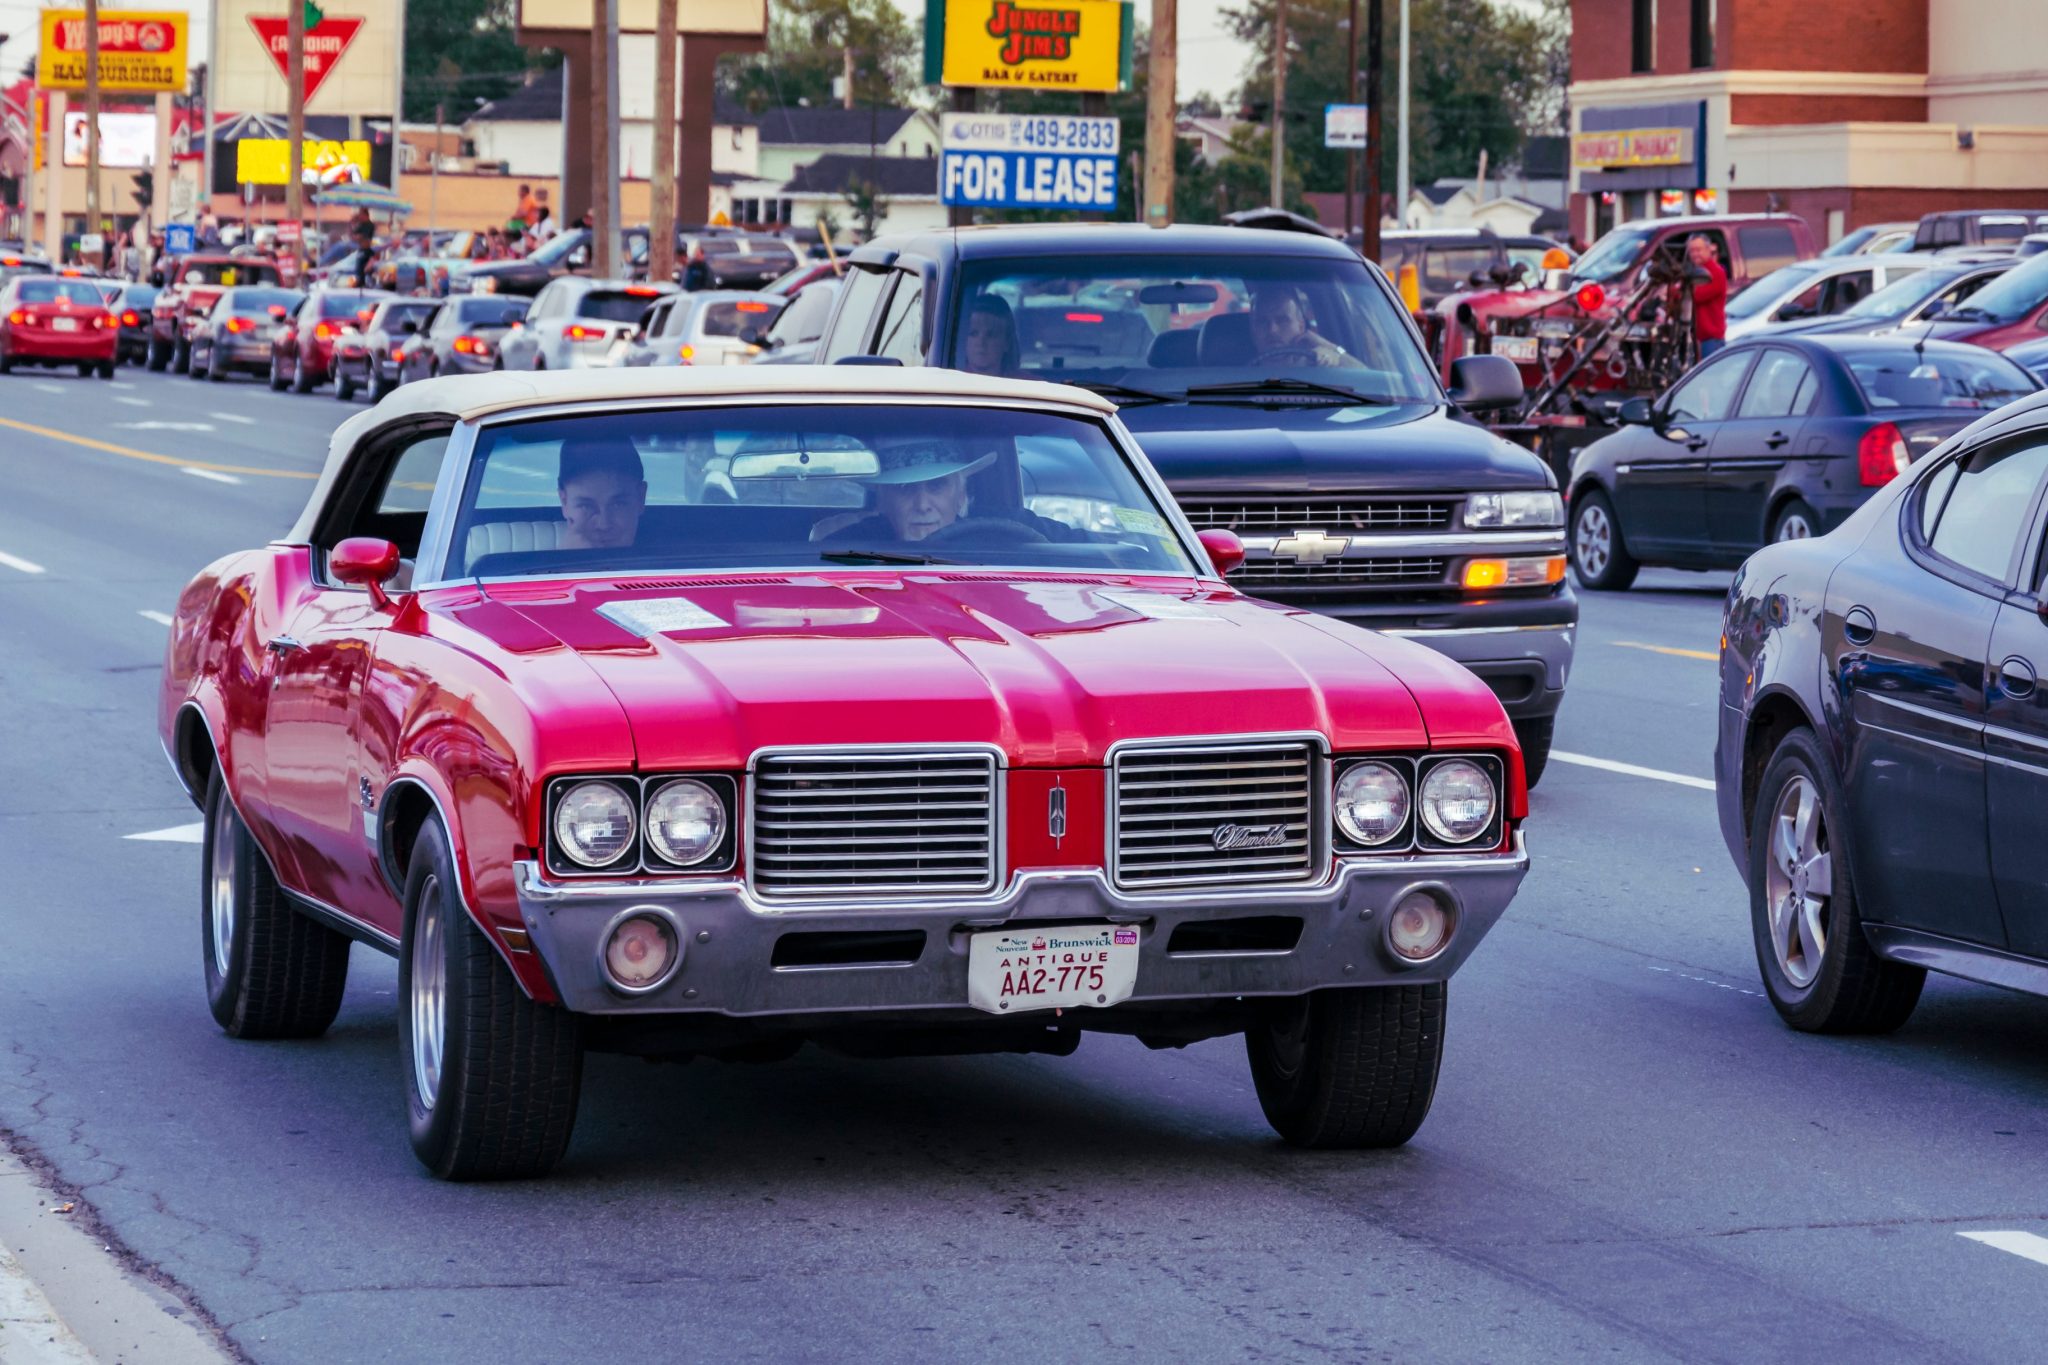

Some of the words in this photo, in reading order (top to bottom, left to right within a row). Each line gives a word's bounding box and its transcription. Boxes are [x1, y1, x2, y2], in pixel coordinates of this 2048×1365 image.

[988, 2, 1079, 36] JUNGLE
[271, 35, 341, 52] CADIAN
[1001, 32, 1068, 64] JIM'S
[983, 68, 1009, 80] BAR
[1029, 71, 1078, 83] EATERY
[971, 122, 1005, 139] OTIS
[1024, 119, 1114, 148] 489-2833
[945, 154, 1006, 200] FOR
[1015, 156, 1116, 204] LEASE
[996, 945, 1028, 953] Nouveau
[1011, 938, 1028, 946] New
[1049, 936, 1112, 949] Brunswick
[1001, 952, 1108, 968] ANTIQUE
[1001, 965, 1104, 997] AA2-775
